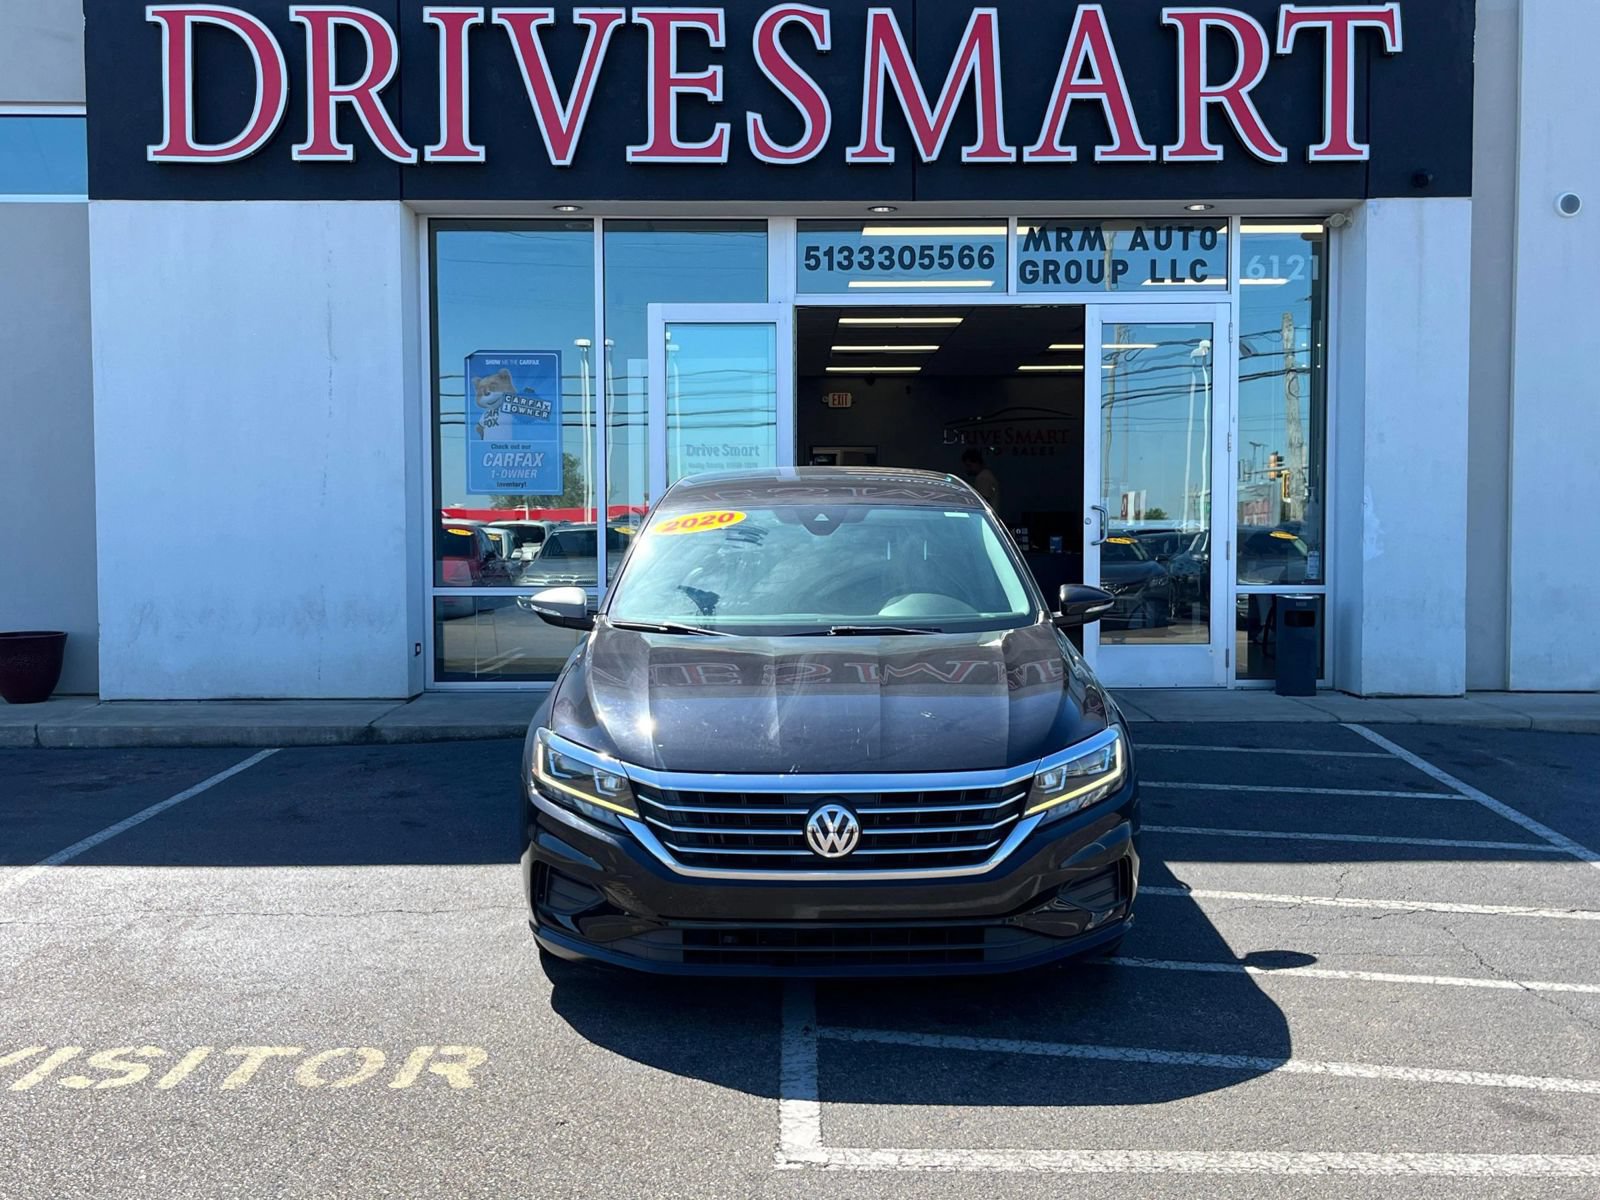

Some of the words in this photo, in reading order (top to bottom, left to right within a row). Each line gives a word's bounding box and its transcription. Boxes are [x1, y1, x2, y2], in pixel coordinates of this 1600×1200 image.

[145, 3, 1403, 167] DRIVESMART
[1022, 226, 1106, 252] MRM
[1128, 226, 1218, 252] AUTO
[804, 245, 995, 272] 5133305566
[1019, 258, 1129, 285] GROUP
[1149, 258, 1209, 284] LLC
[1246, 254, 1319, 280] 6121
[832, 393, 848, 406] EXIT
[483, 452, 544, 467] CARFAX
[686, 443, 720, 457] Drive
[662, 512, 736, 533] 2020
